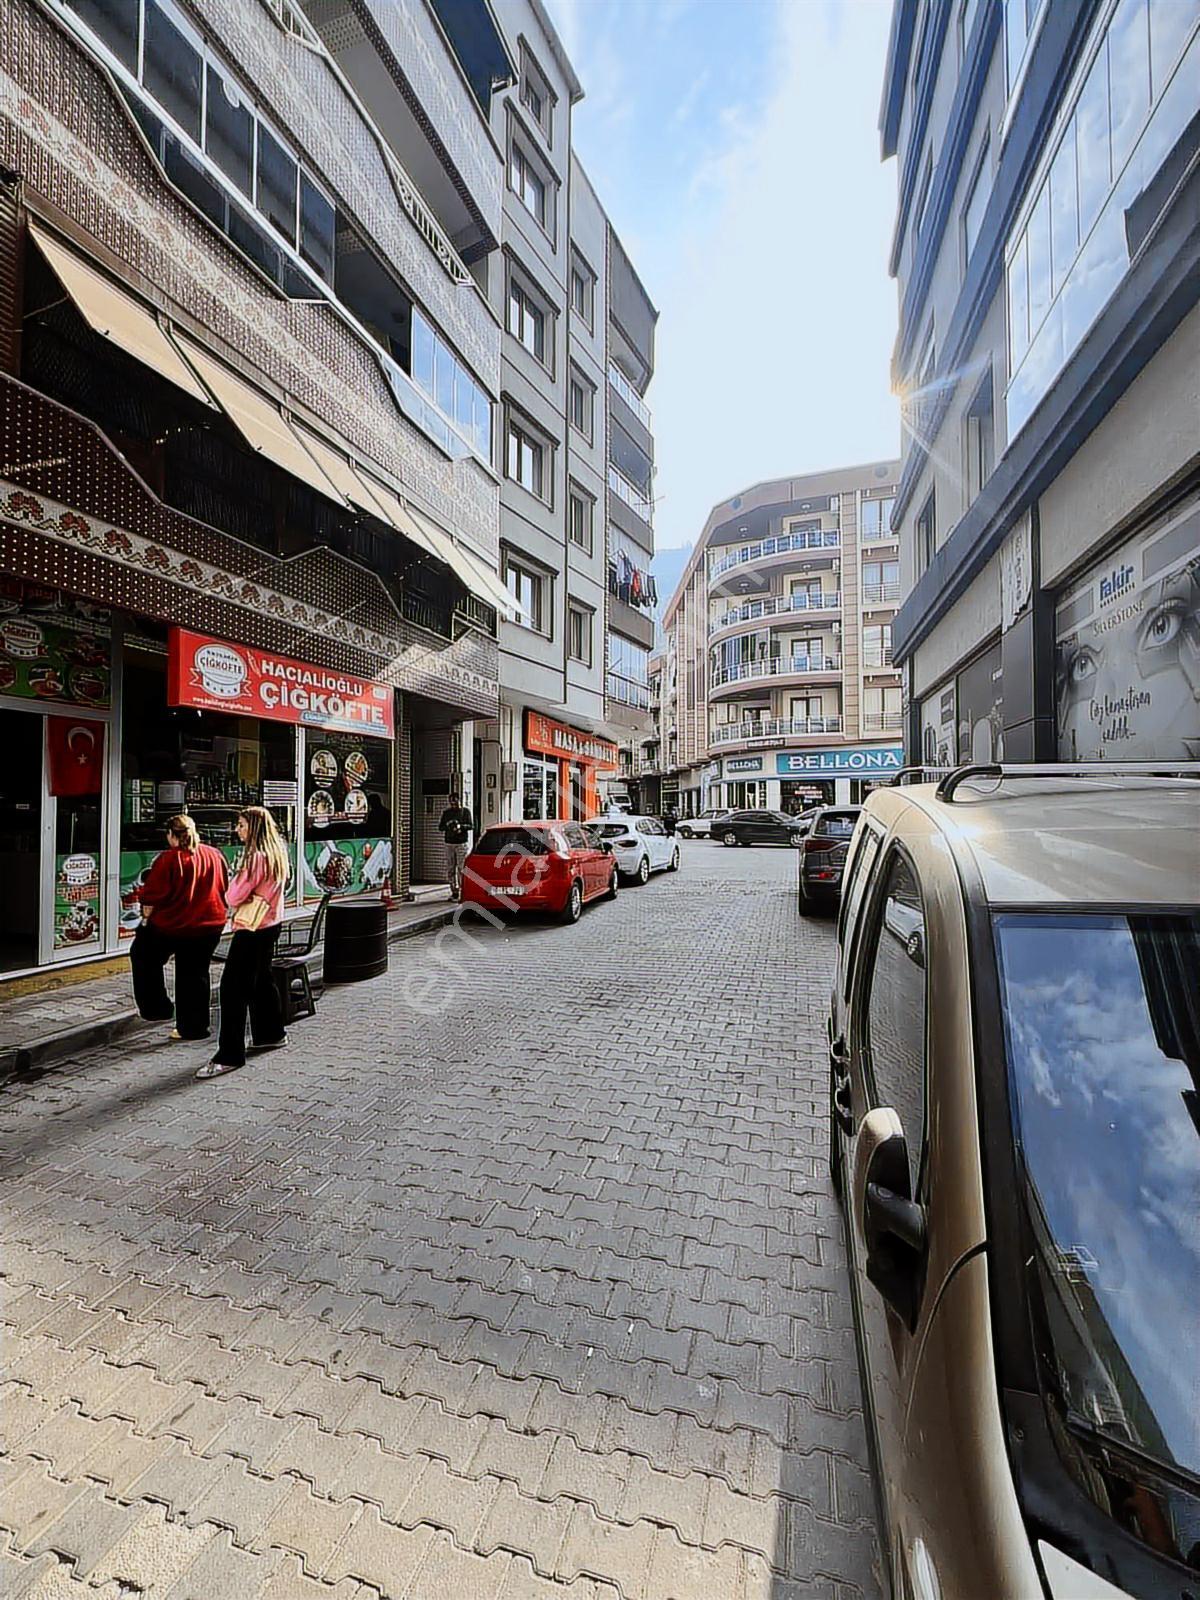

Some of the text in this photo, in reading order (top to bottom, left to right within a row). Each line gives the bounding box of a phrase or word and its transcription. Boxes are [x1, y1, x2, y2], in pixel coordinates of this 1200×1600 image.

[261, 660, 363, 697] HACIALİOĞLU
[259, 681, 384, 724] ÇİĞKÖFTE
[554, 728, 578, 756] MASA
[787, 751, 901, 770] BELLONA
